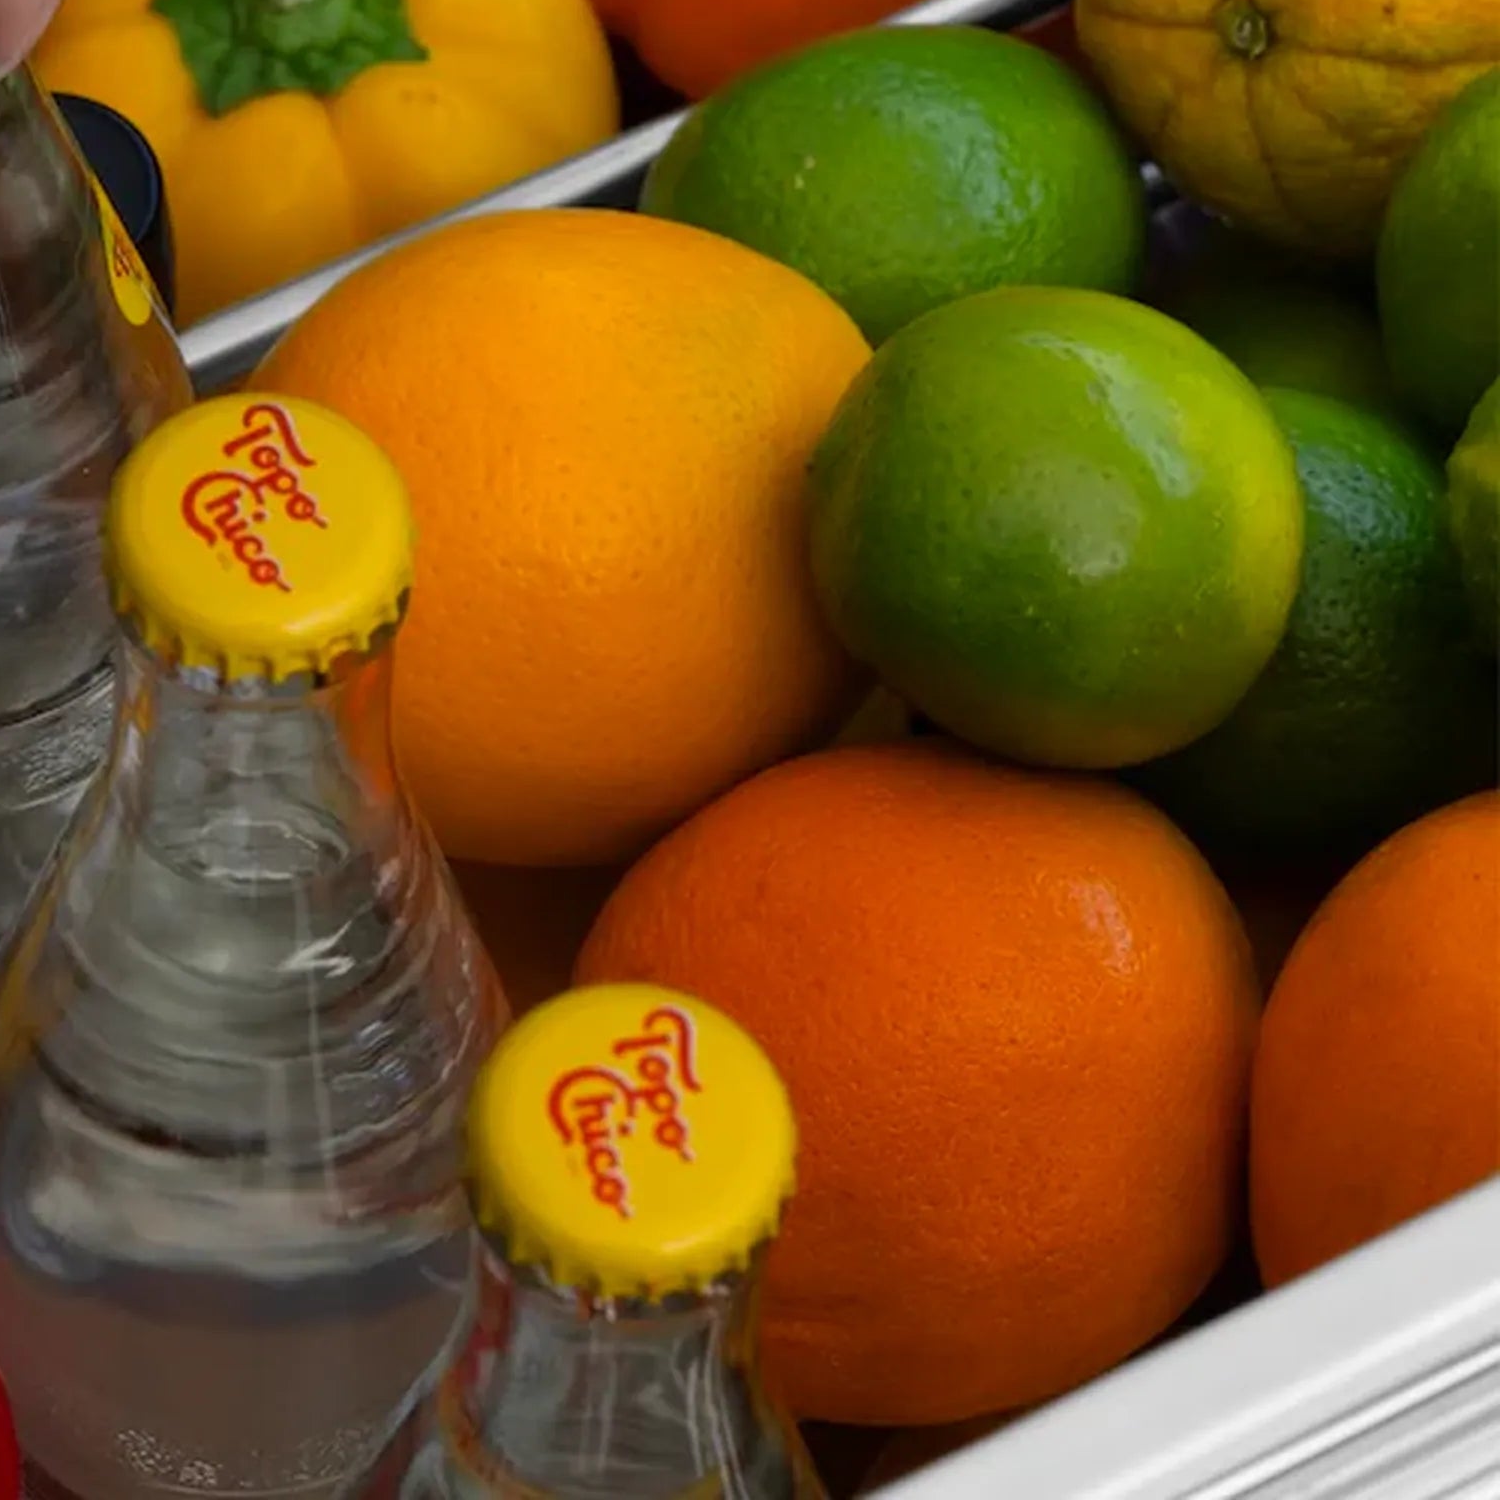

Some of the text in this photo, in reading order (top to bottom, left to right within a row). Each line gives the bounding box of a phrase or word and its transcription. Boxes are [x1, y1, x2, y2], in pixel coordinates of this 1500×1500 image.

[181, 470, 293, 593] Chico
[222, 404, 329, 529] Topo
[548, 1066, 638, 1220] Chico
[612, 1005, 703, 1163] Topo
